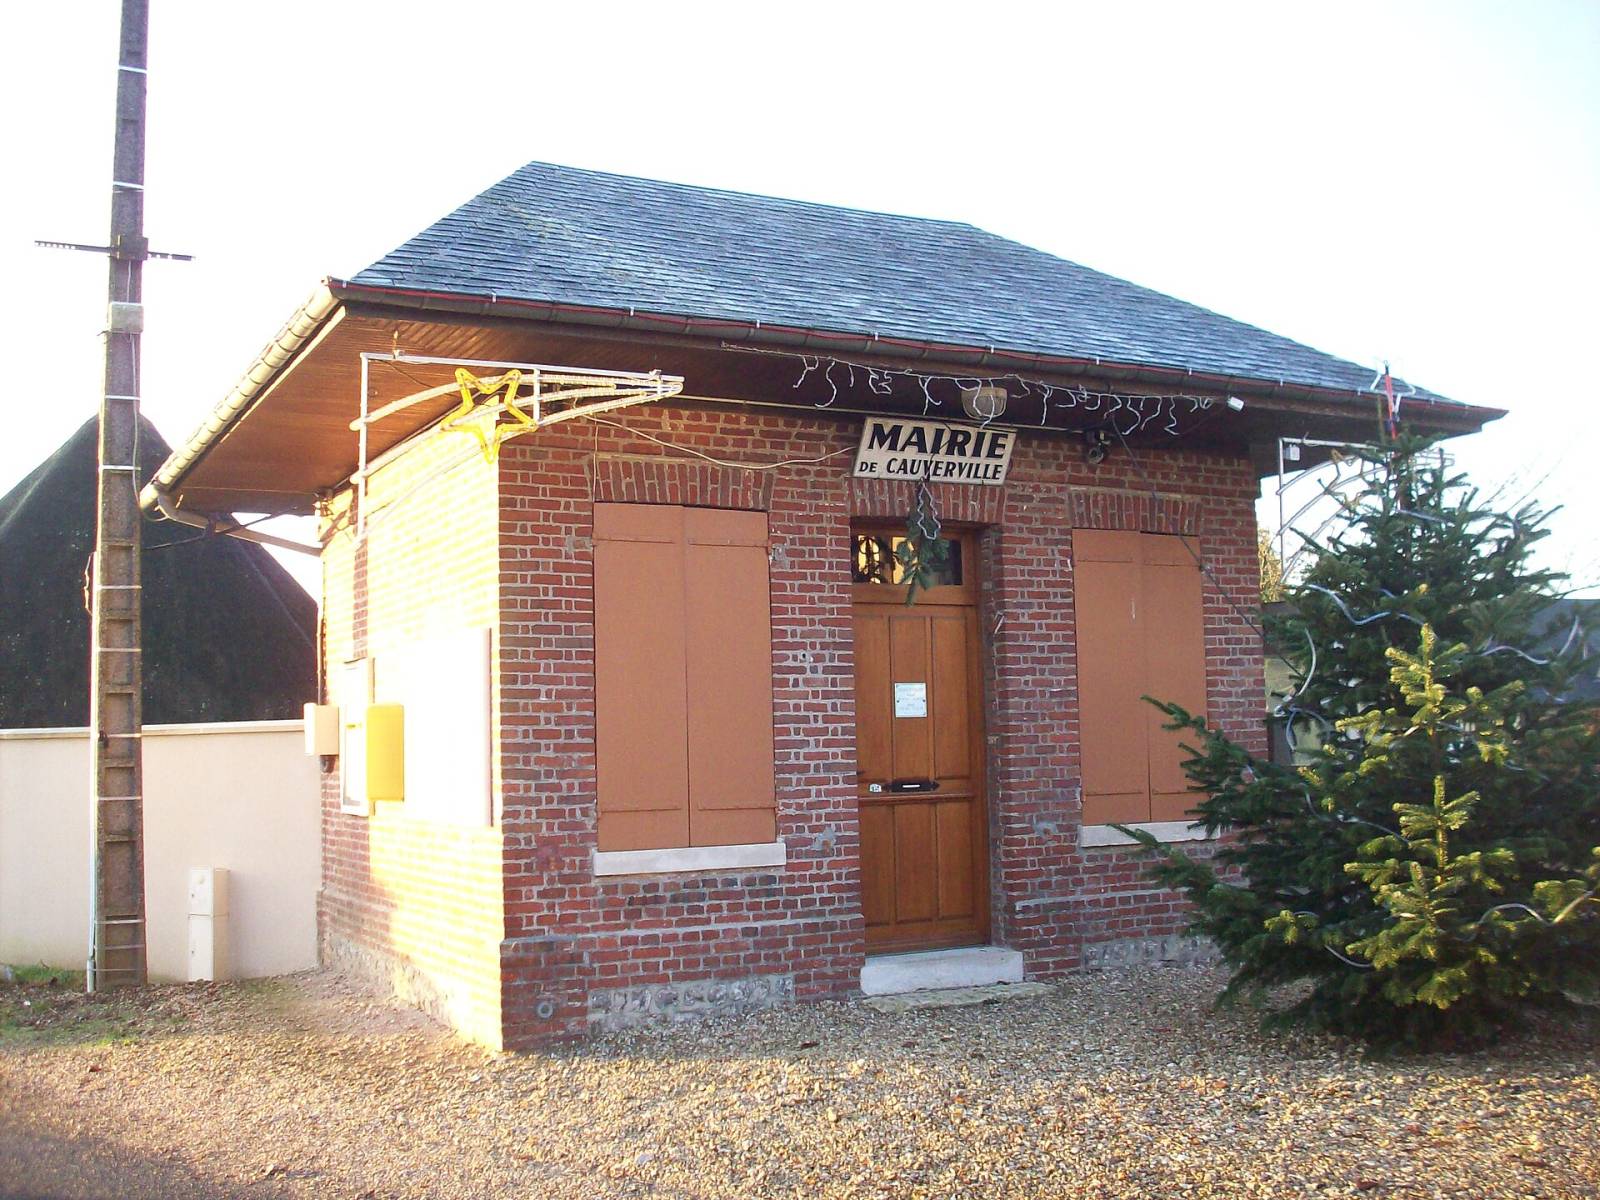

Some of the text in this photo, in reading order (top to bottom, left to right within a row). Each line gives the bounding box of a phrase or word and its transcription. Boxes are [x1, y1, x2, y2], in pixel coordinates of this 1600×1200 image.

[868, 423, 1008, 459] MAIRIE
[858, 457, 1003, 480] DE CAUVERVILLE
